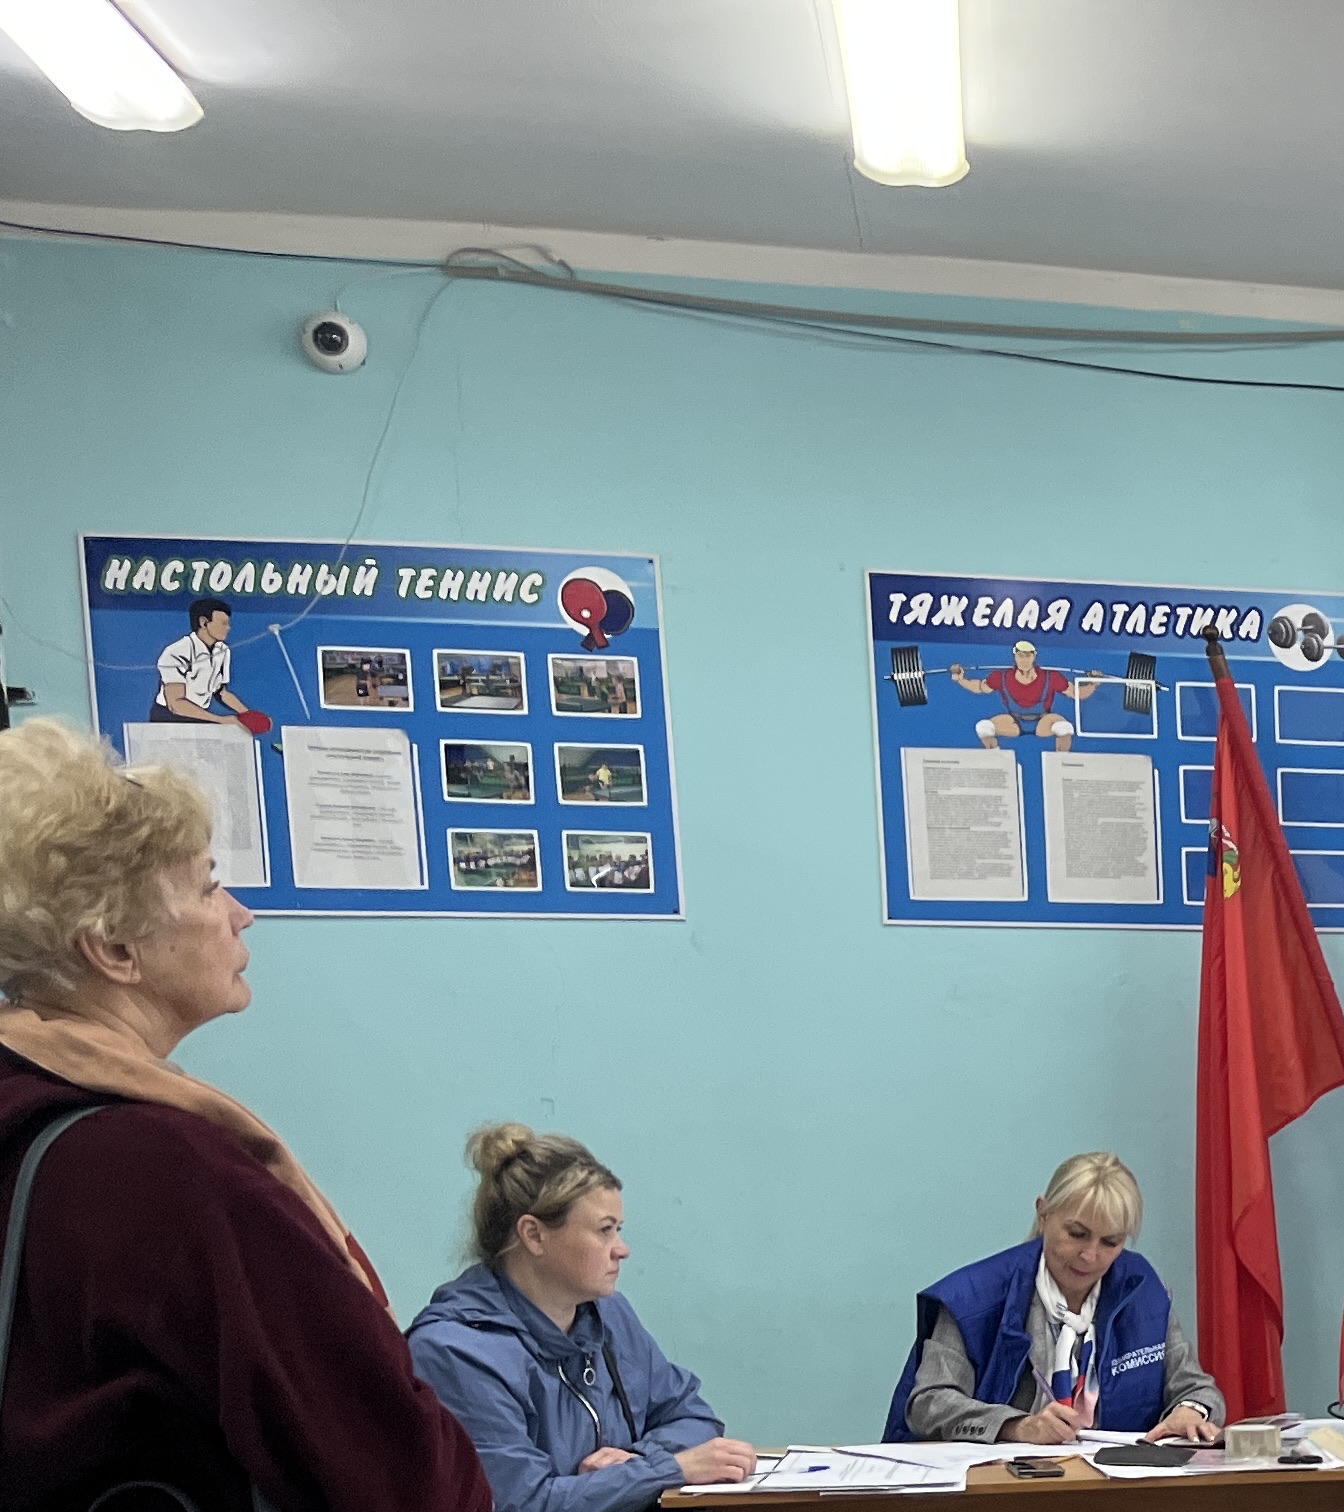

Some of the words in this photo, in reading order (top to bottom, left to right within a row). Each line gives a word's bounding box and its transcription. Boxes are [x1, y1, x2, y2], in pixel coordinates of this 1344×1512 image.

[103, 558, 379, 597] НАСТОЛЬНЫЙ
[397, 567, 545, 603] ТЕННИС
[888, 592, 1071, 632] ТЯЖЕЛАЯ
[1081, 601, 1261, 641] АТЛЕТИКА
